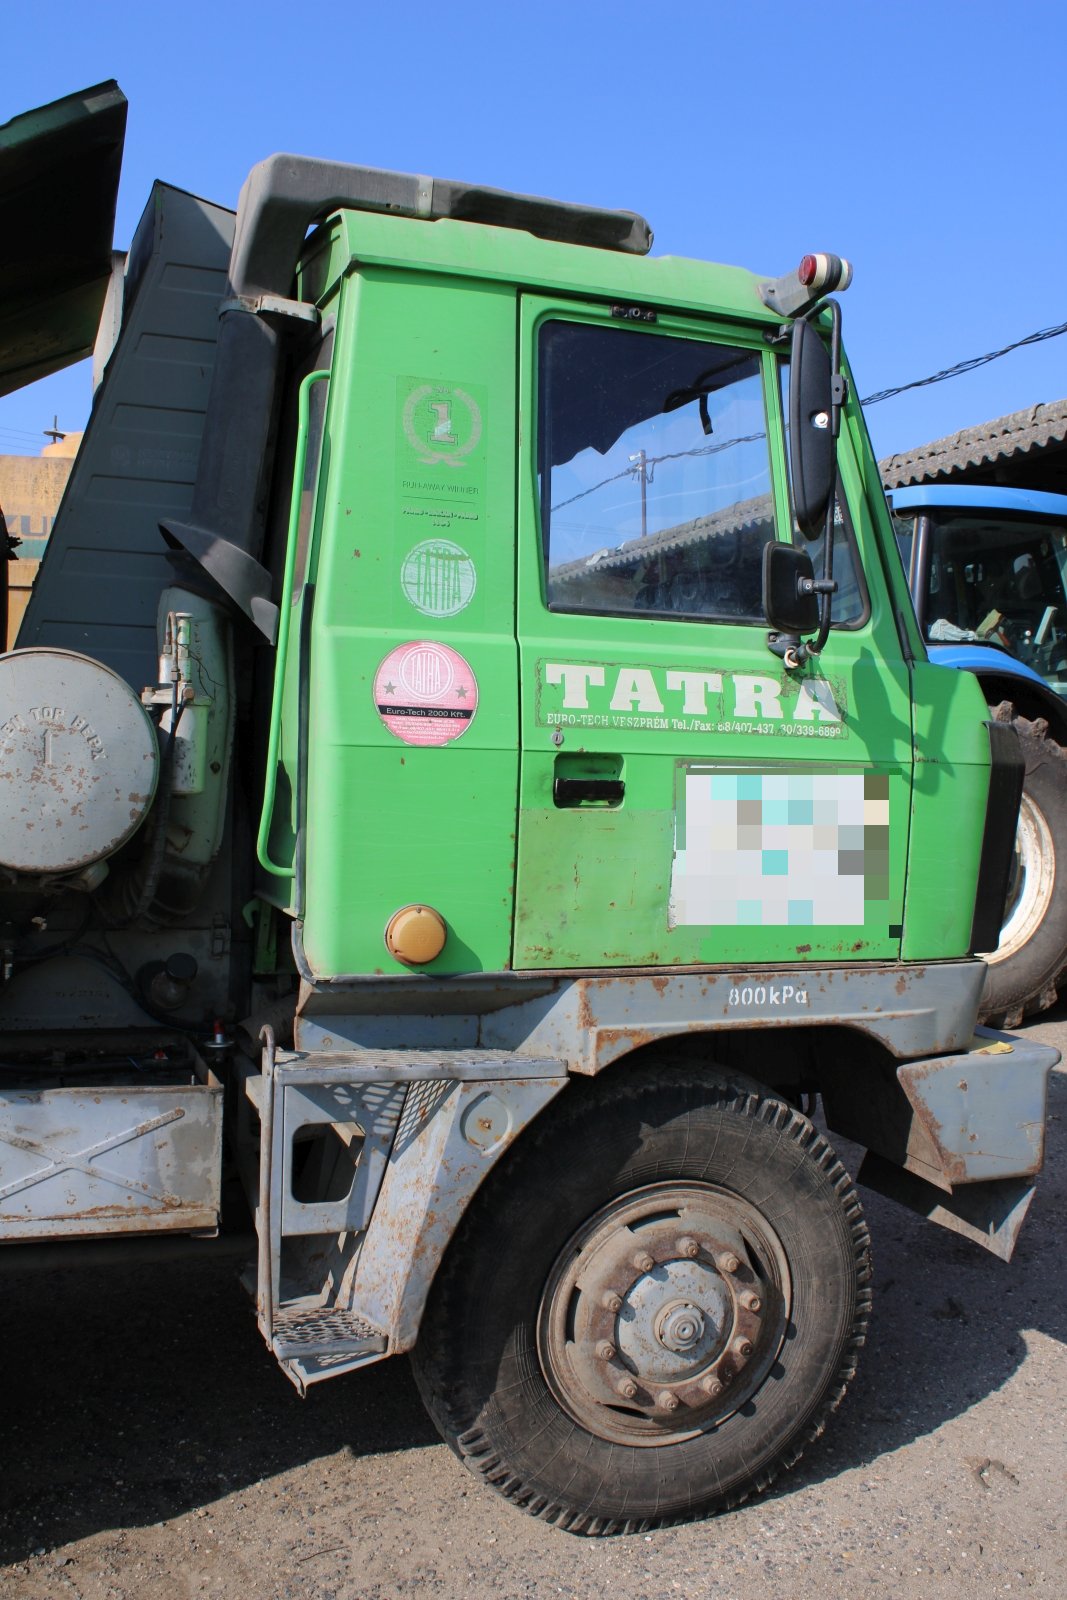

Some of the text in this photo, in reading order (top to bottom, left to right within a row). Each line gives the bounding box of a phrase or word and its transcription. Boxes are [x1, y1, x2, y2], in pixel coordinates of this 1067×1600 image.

[411, 652, 441, 695] TATRA
[545, 663, 843, 723] TATRA
[30, 707, 65, 721] TOP
[386, 707, 466, 718] Euro-Tech 2000 Kft.
[546, 713, 609, 726] EURO-TECH
[671, 718, 715, 731] Tel./Fax:
